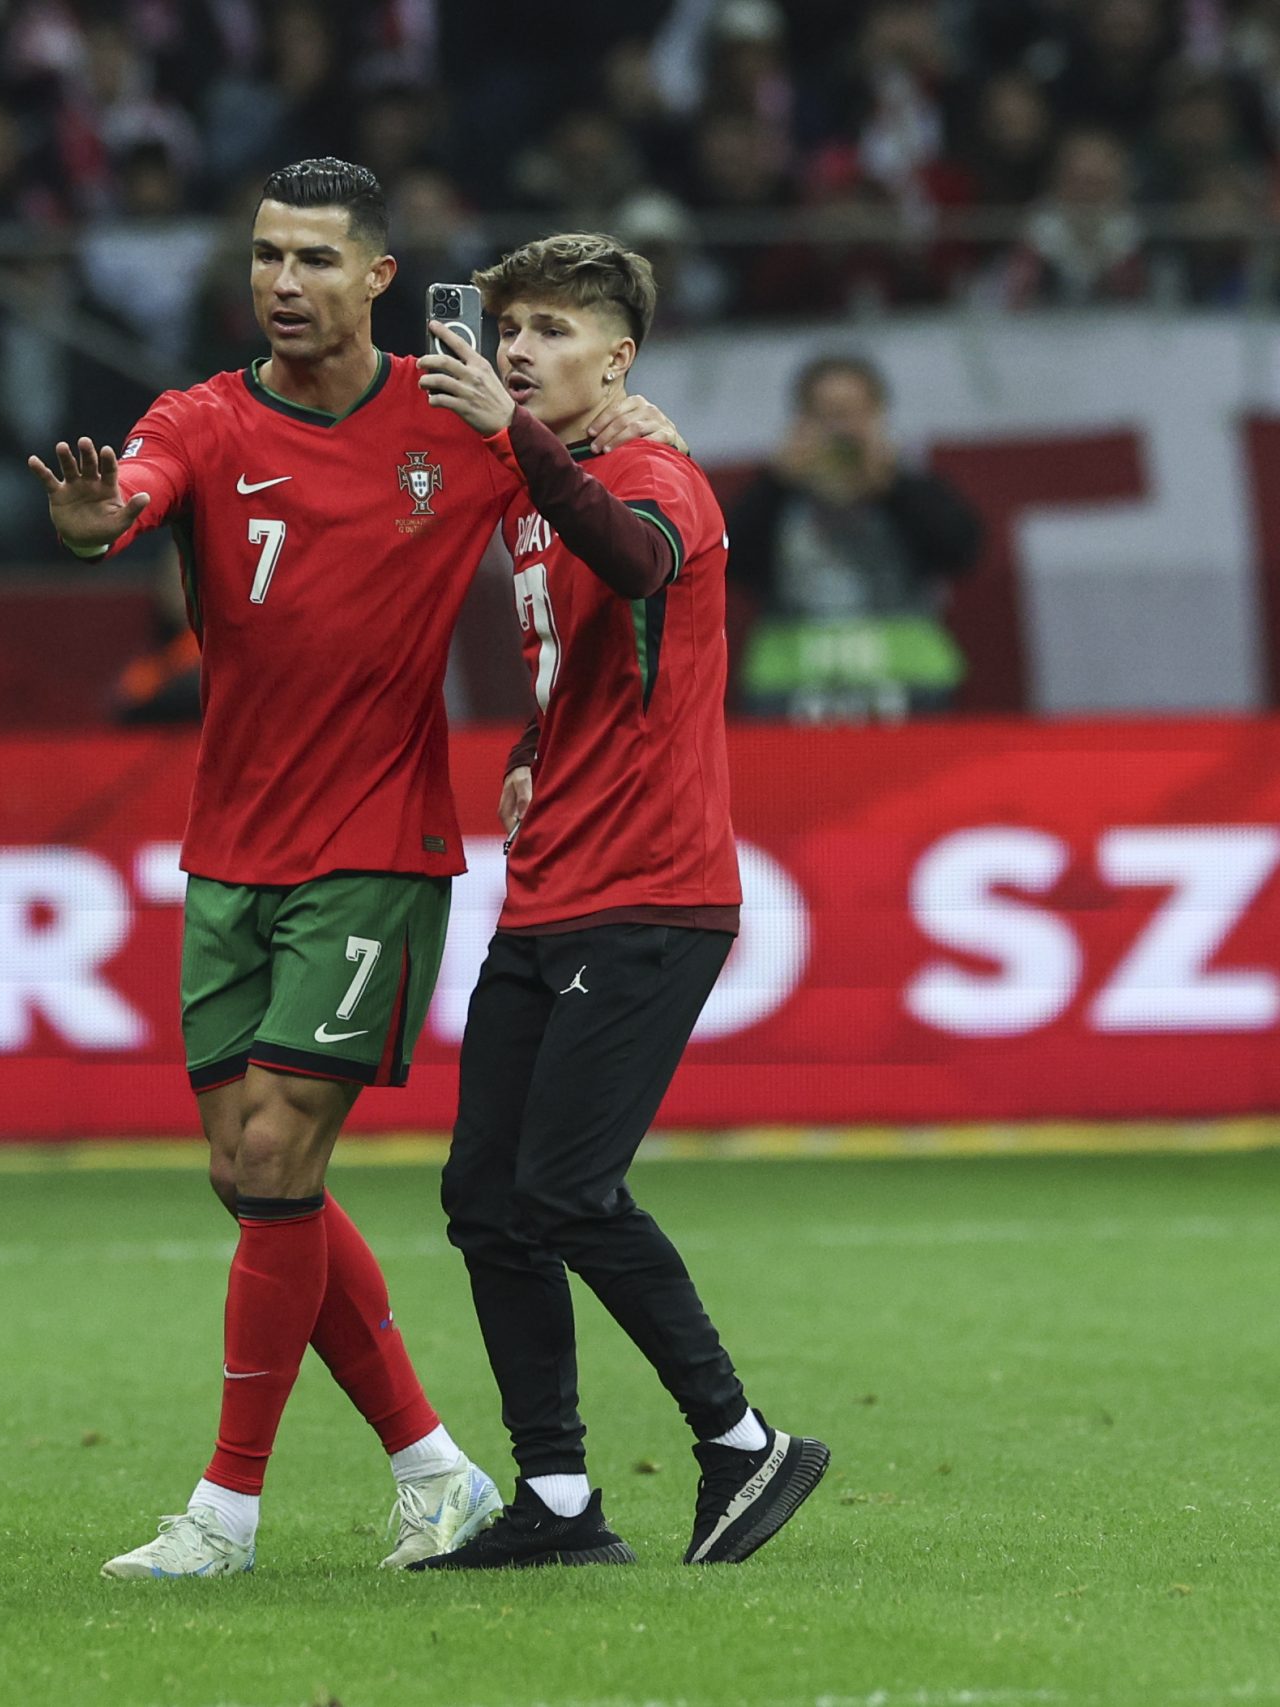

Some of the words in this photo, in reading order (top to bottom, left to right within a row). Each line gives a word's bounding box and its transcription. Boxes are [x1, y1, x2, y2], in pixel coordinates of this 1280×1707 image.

[248, 519, 286, 604] 7
[513, 562, 561, 716] 7
[336, 936, 382, 1020] 7
